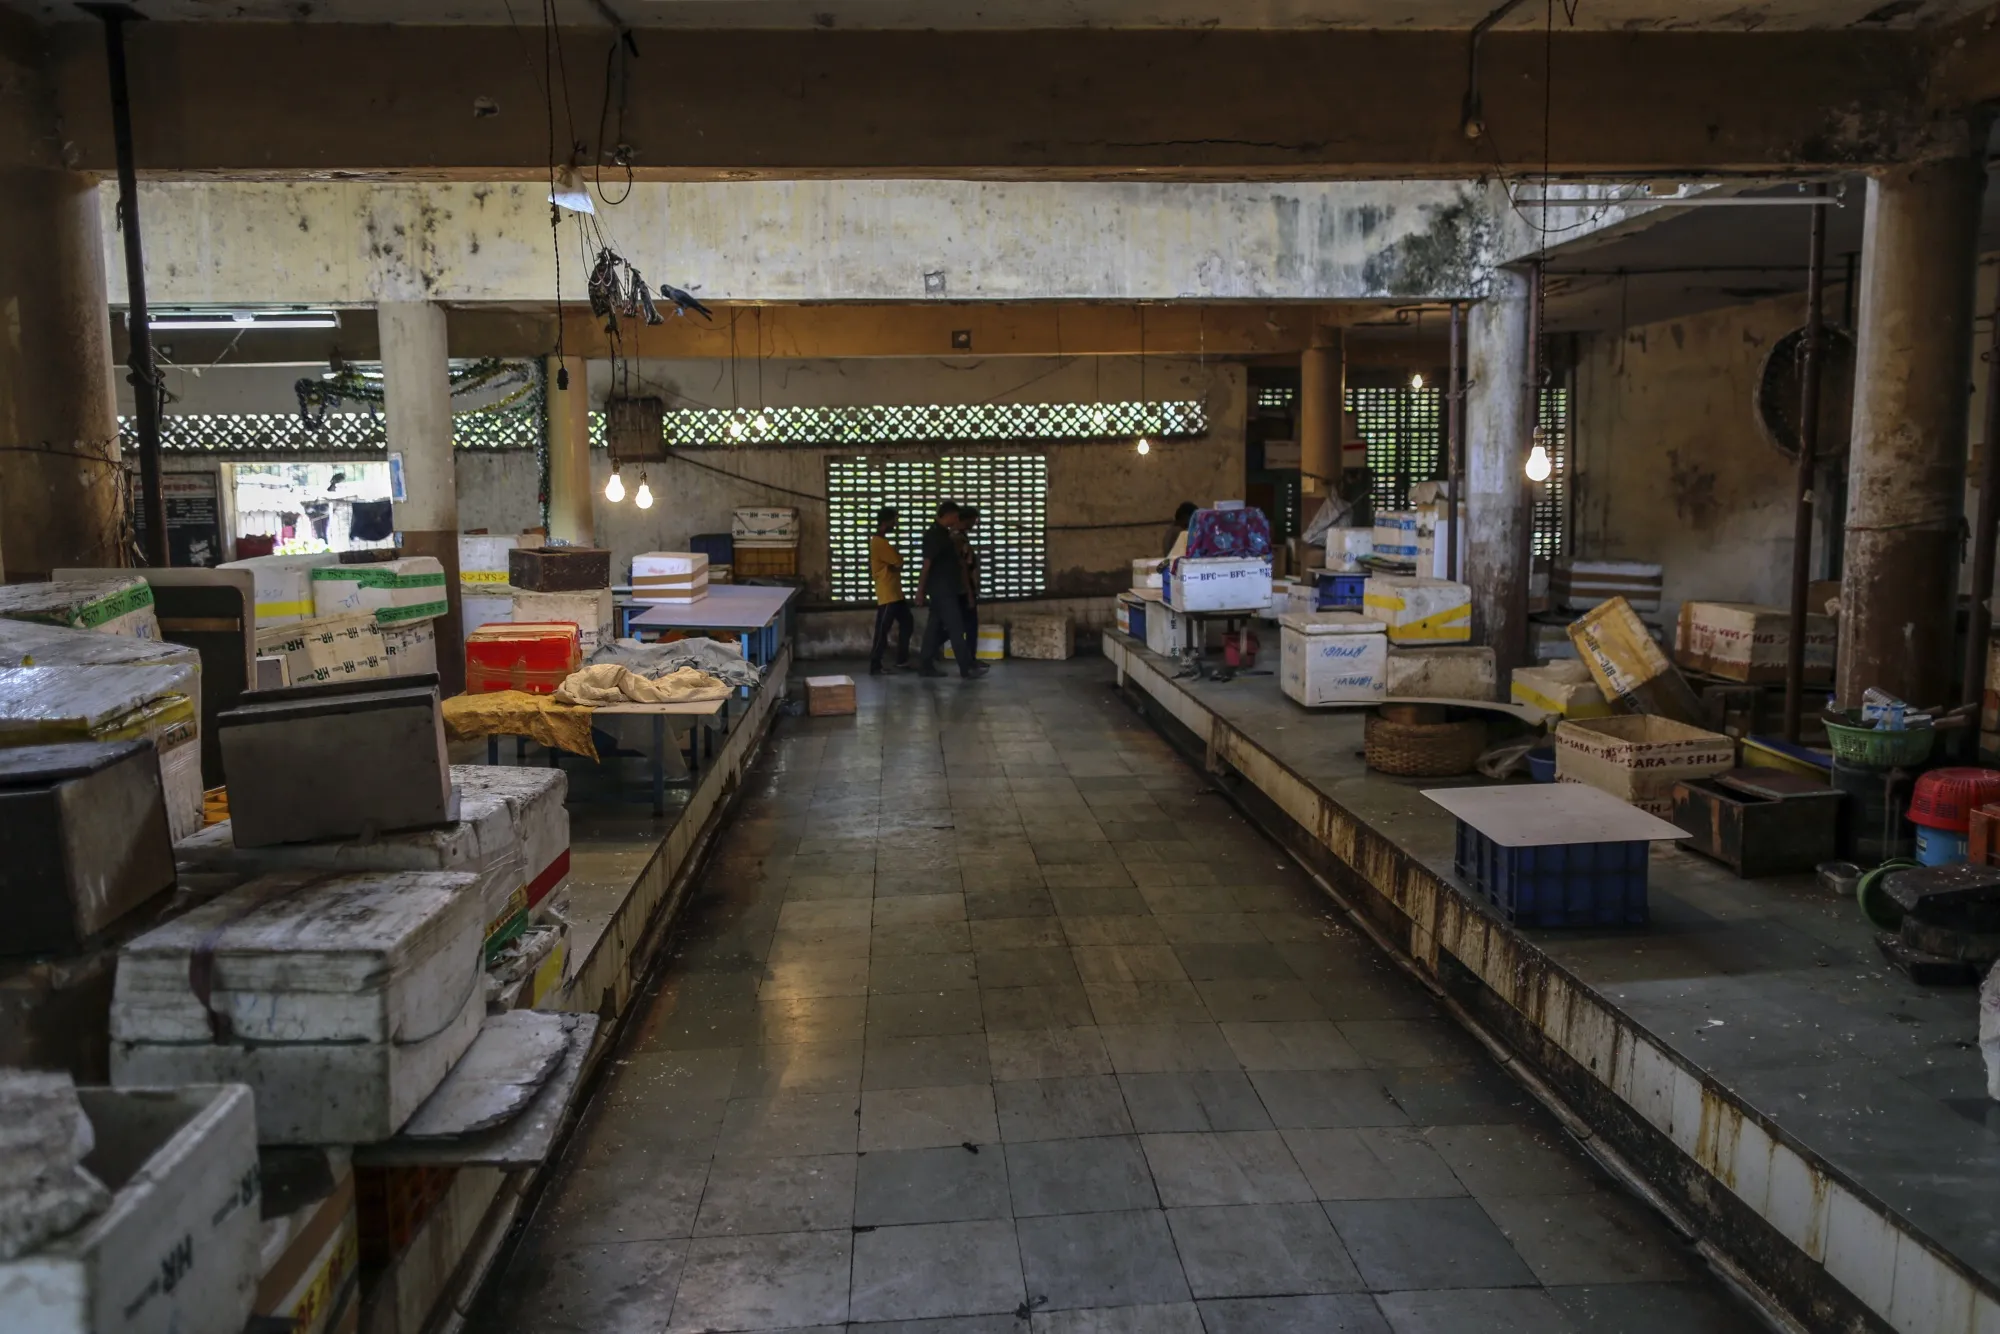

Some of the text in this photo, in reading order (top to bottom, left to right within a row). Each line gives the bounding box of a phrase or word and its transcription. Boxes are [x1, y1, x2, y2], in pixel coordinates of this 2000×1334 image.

[1200, 572, 1217, 581] BFC
[1230, 570, 1246, 579] BFC
[320, 631, 334, 644] HR
[346, 626, 359, 639] HR
[286, 638, 305, 652] HR
[343, 660, 357, 673] HR
[367, 655, 379, 668] HR
[314, 666, 330, 681] HR
[1570, 740, 1590, 754] SARA
[1627, 757, 1666, 768] SARA
